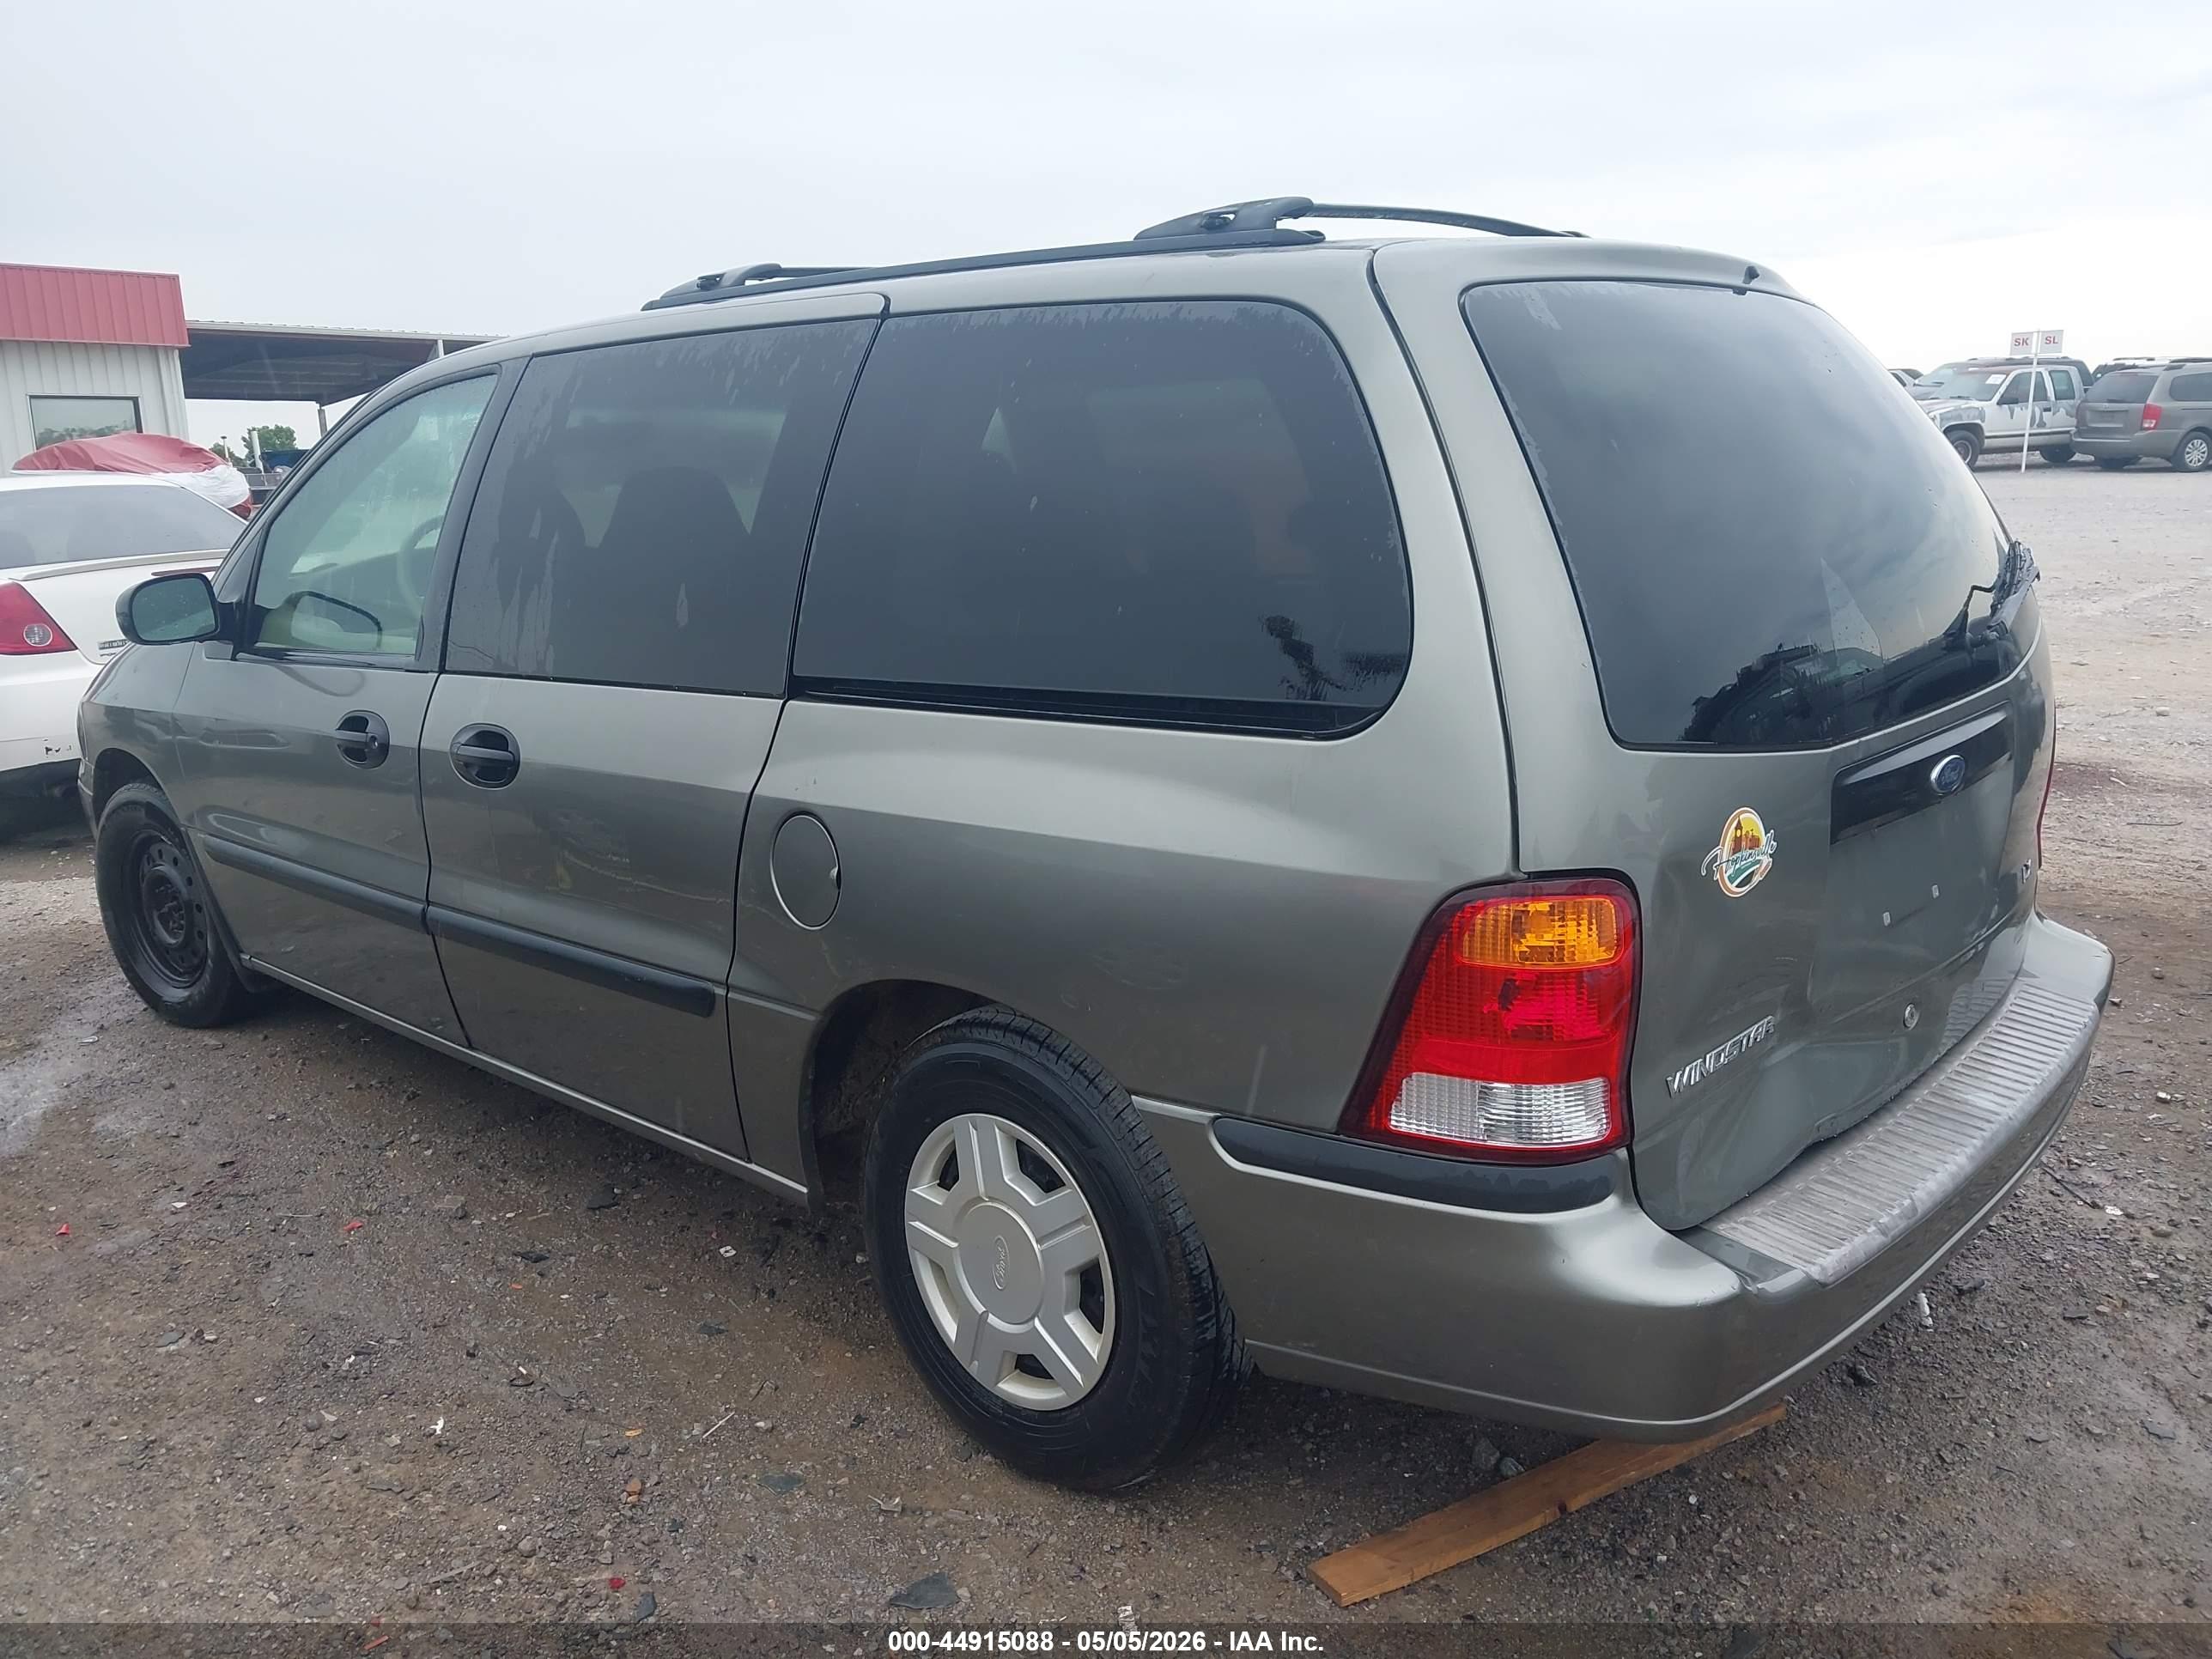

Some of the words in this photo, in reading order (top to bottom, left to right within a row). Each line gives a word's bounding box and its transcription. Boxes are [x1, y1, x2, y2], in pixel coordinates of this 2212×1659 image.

[2014, 337, 2029, 346] SK
[2045, 336, 2058, 344] SL
[1666, 1015, 1775, 1099] WINDSTAR
